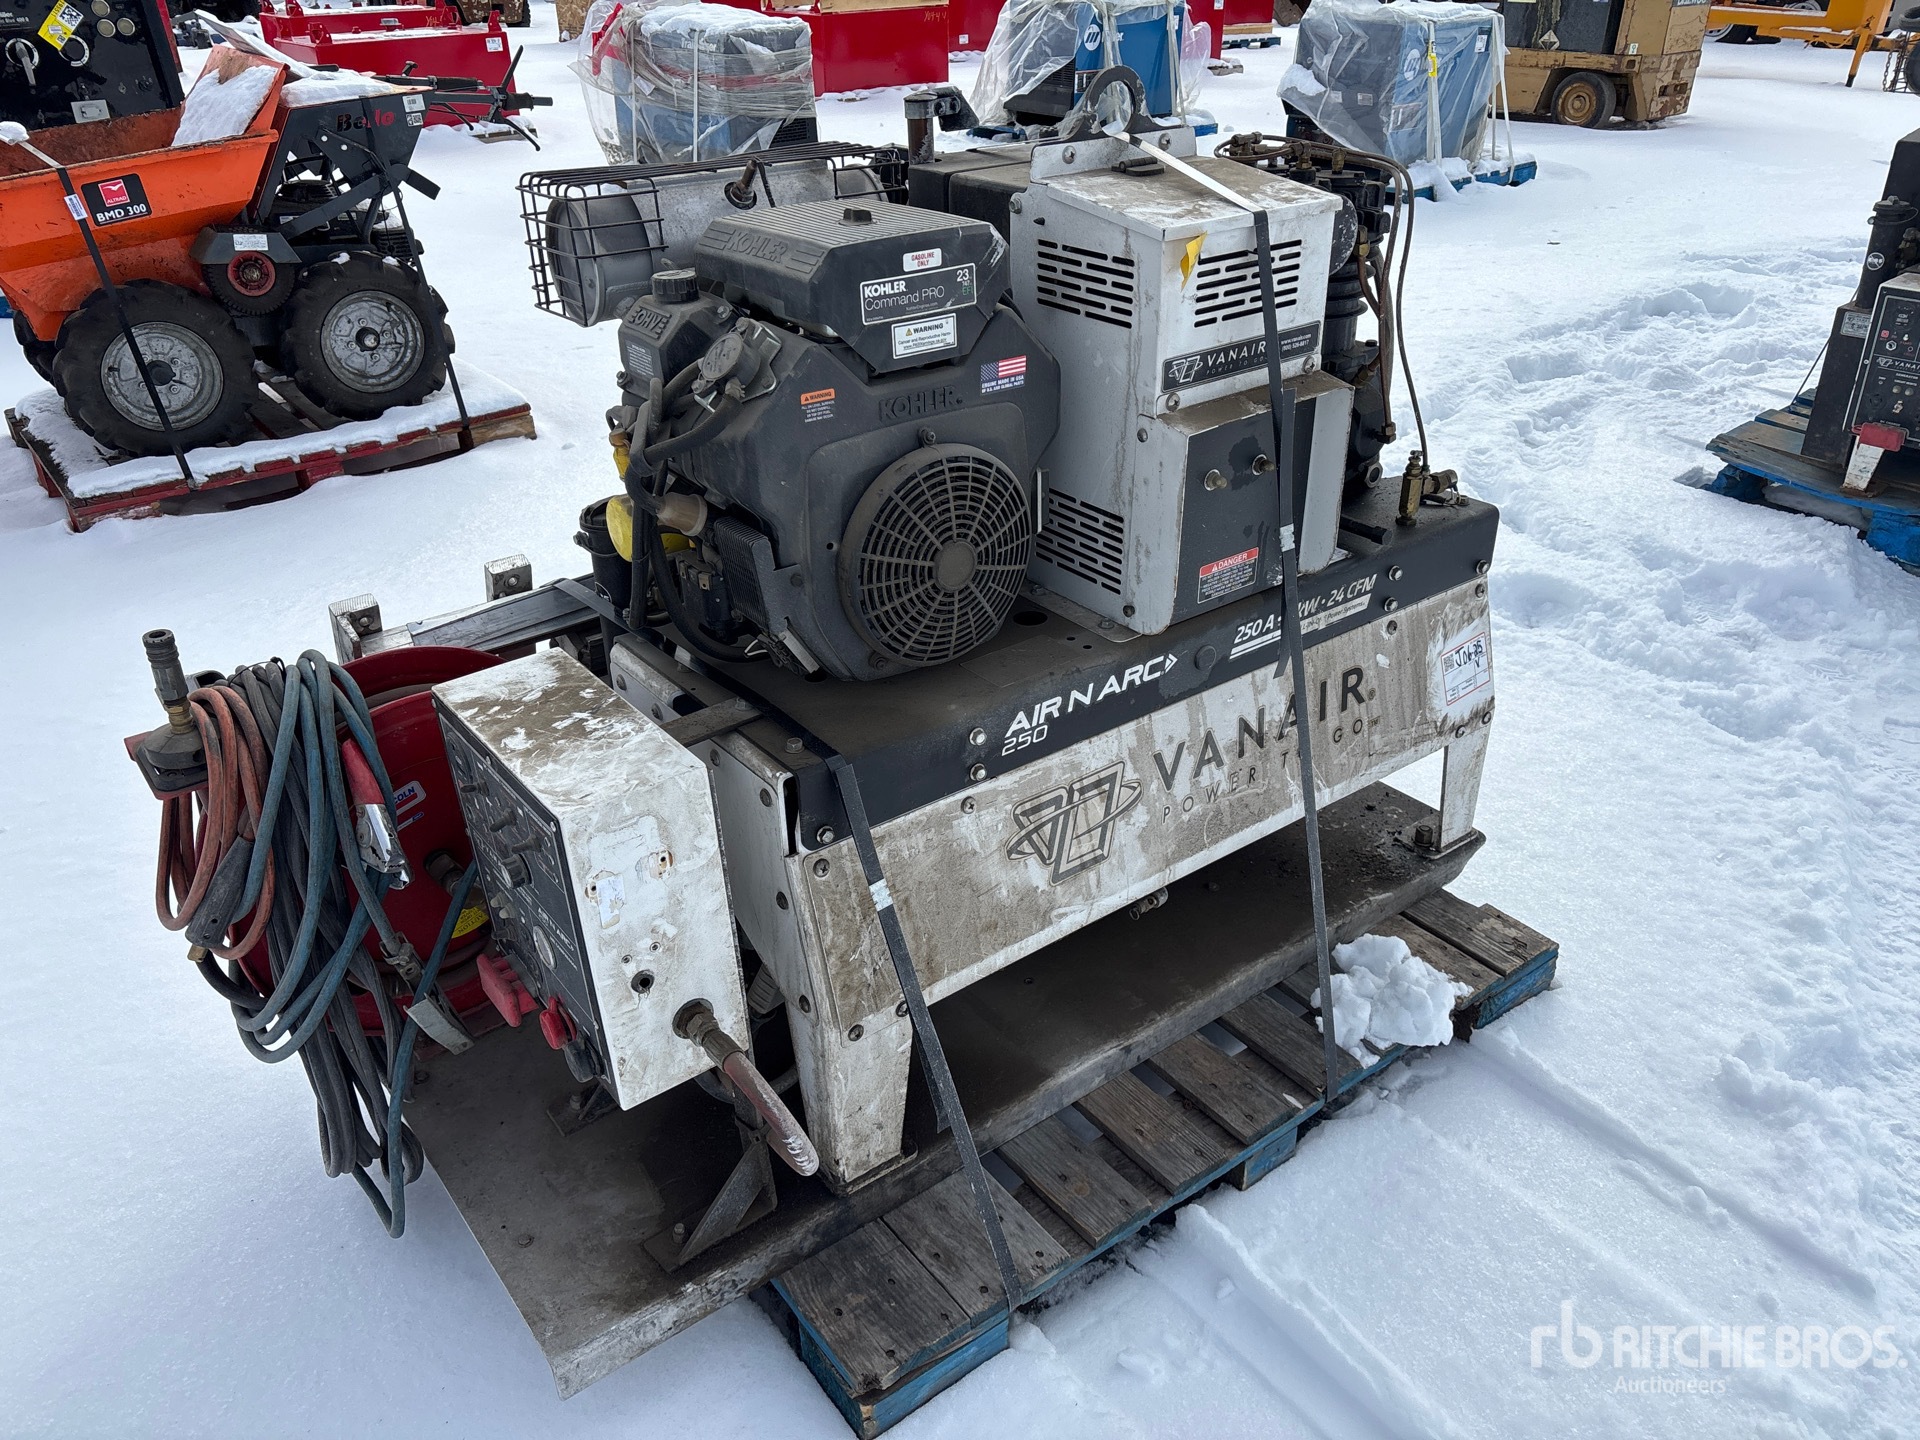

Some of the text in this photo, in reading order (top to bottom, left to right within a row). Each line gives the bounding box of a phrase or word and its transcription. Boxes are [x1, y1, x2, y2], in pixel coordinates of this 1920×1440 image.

[96, 203, 147, 223] BMD 300
[727, 230, 790, 265] KOHLER
[911, 251, 936, 262] GASOLINE
[917, 259, 930, 268] ONLY
[956, 268, 970, 283] 23
[864, 280, 907, 298] KOHLER
[864, 290, 920, 311] Command
[921, 286, 945, 301] PRO
[962, 285, 974, 296] EFI
[912, 322, 944, 335] WARNING
[1207, 340, 1267, 368] VANAIR
[809, 391, 832, 400] WARNING
[878, 385, 957, 423] KOHLER
[1218, 552, 1248, 570] DANGER
[1234, 621, 1262, 645] 250
[1262, 613, 1275, 632] A
[1326, 584, 1345, 607] 24
[1346, 573, 1378, 598] CFM
[1004, 655, 1165, 739] AIR N ARC
[1001, 724, 1049, 757] 250
[1153, 667, 1366, 792] VANAIR
[1162, 767, 1256, 824] POWER
[1332, 718, 1364, 744] GO
